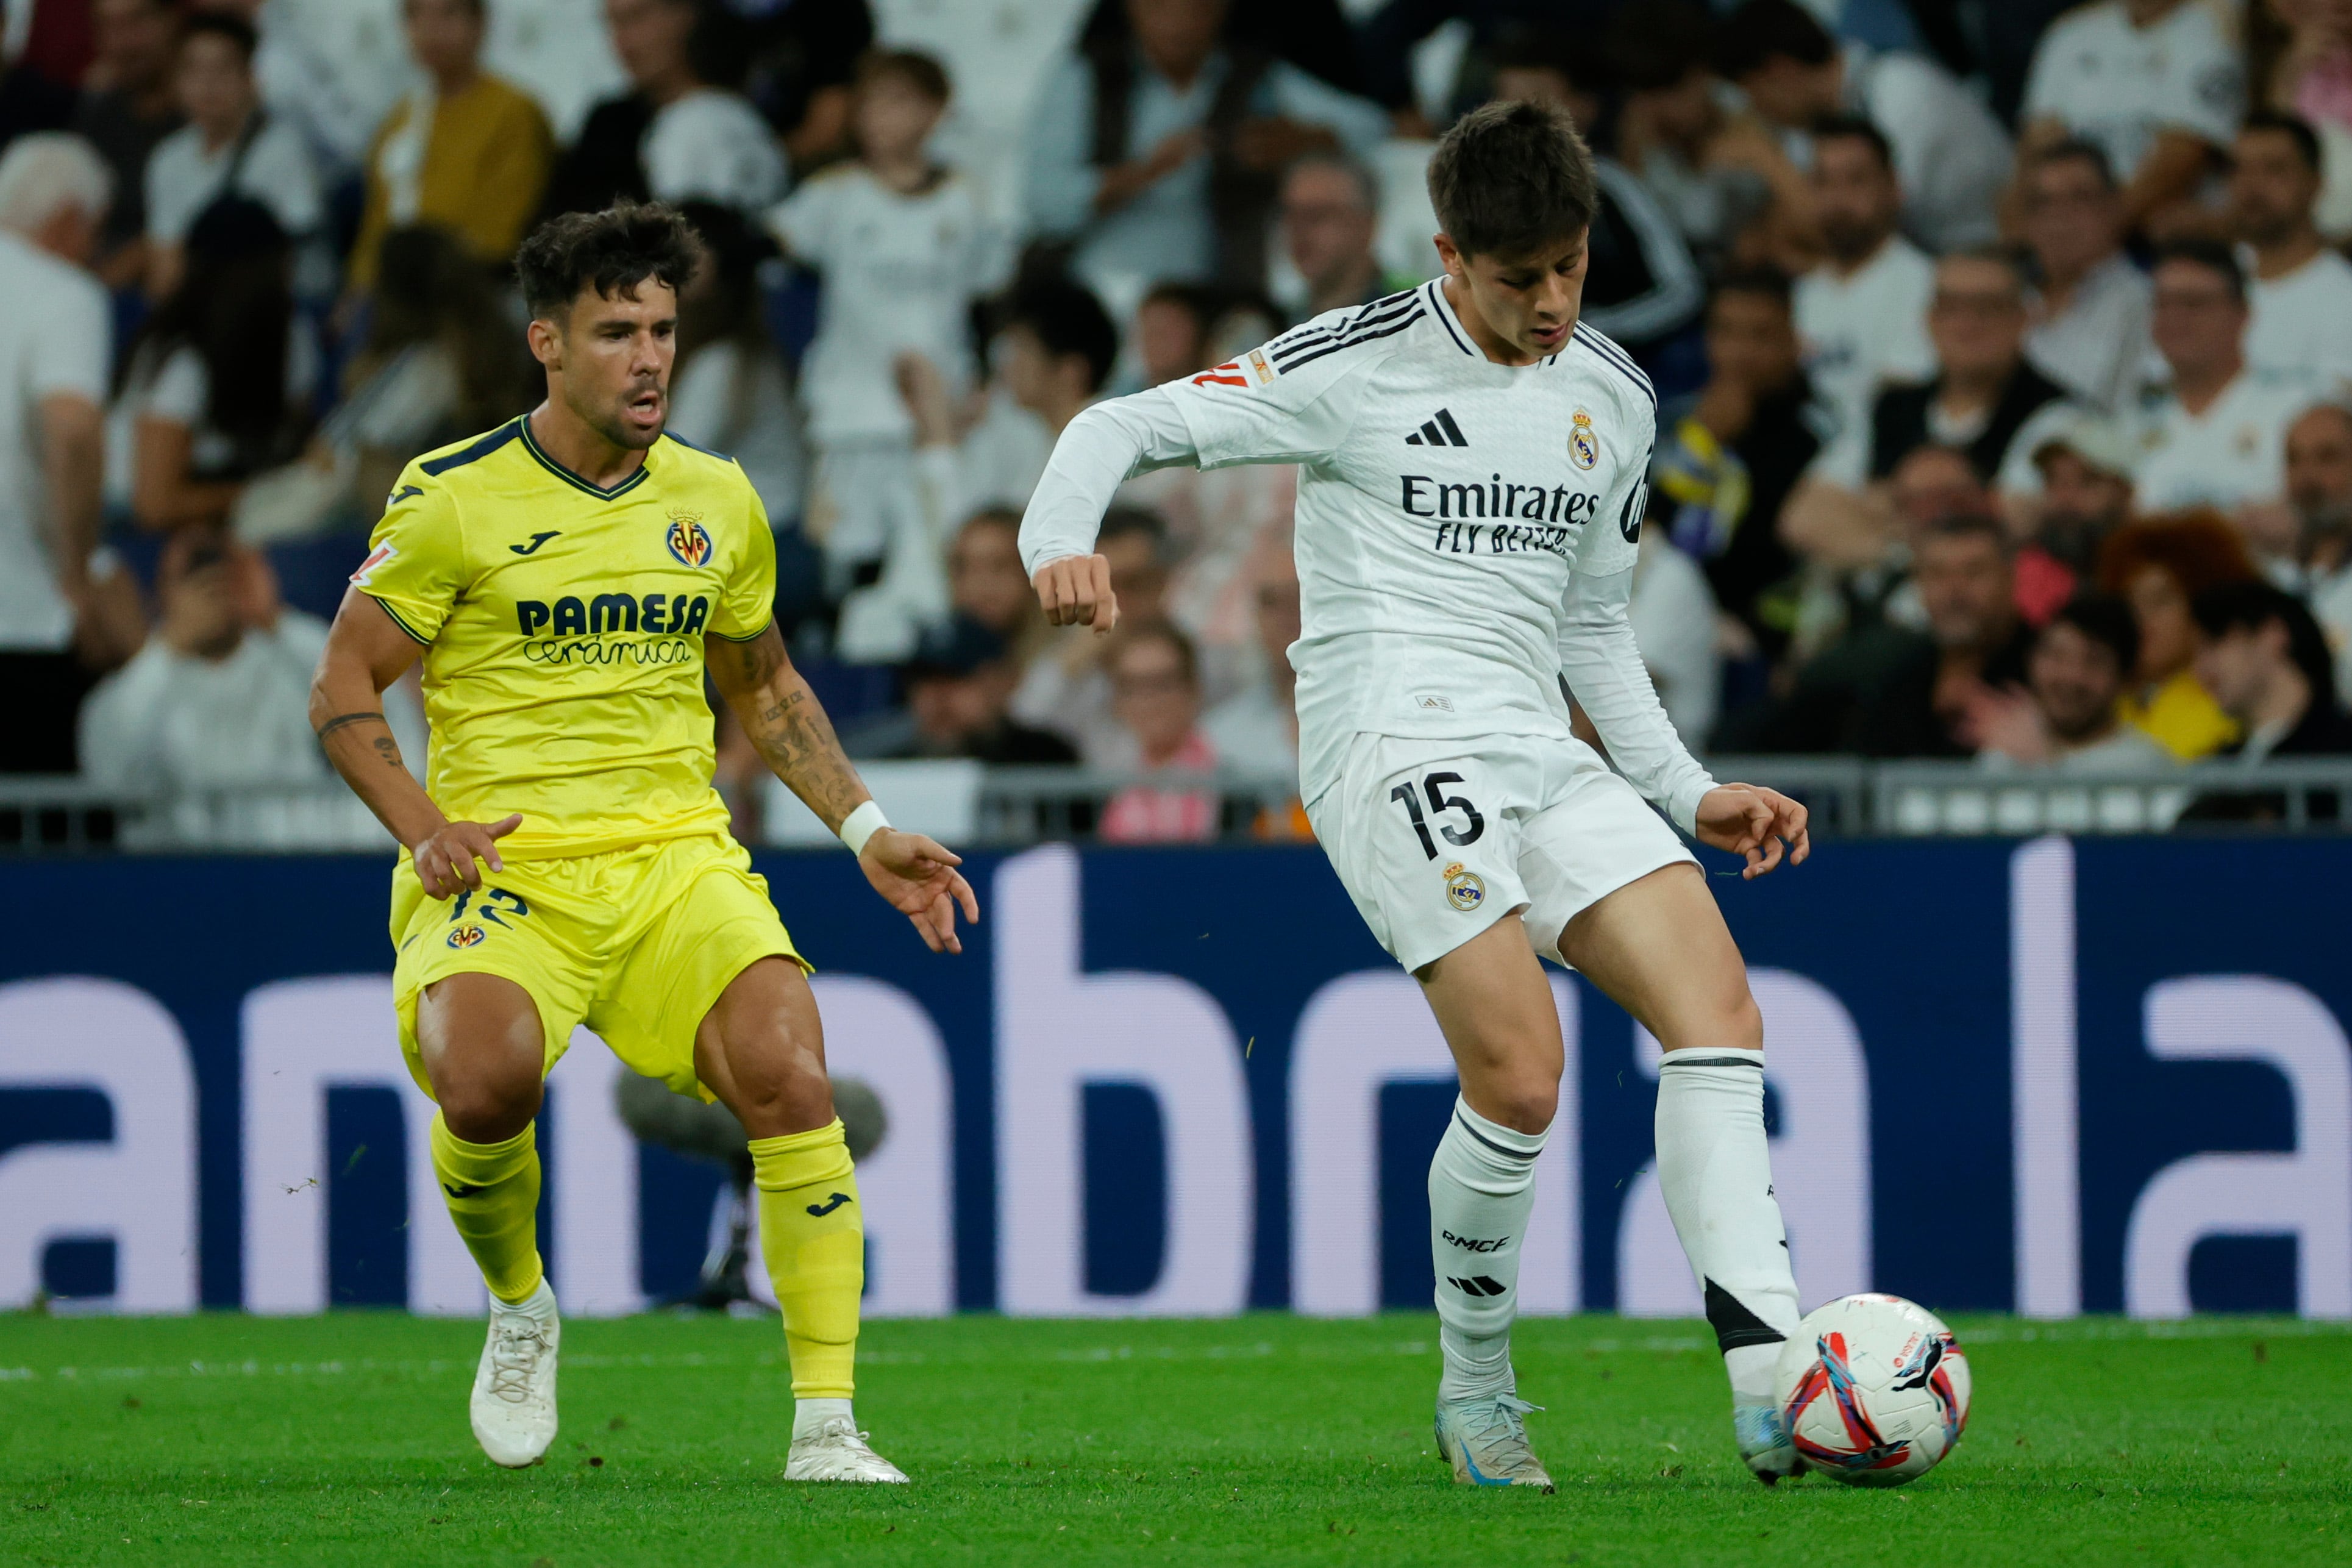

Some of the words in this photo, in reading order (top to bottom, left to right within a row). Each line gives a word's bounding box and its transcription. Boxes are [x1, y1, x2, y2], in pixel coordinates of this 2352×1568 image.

[1400, 472, 1600, 525] Emirates
[1435, 523, 1484, 554] FLY
[1491, 524, 1569, 555] BETTER
[516, 593, 708, 636] PAMESA
[523, 635, 691, 665] cerámica
[1391, 772, 1484, 861] 15
[1442, 1229, 1511, 1253] RMCF
